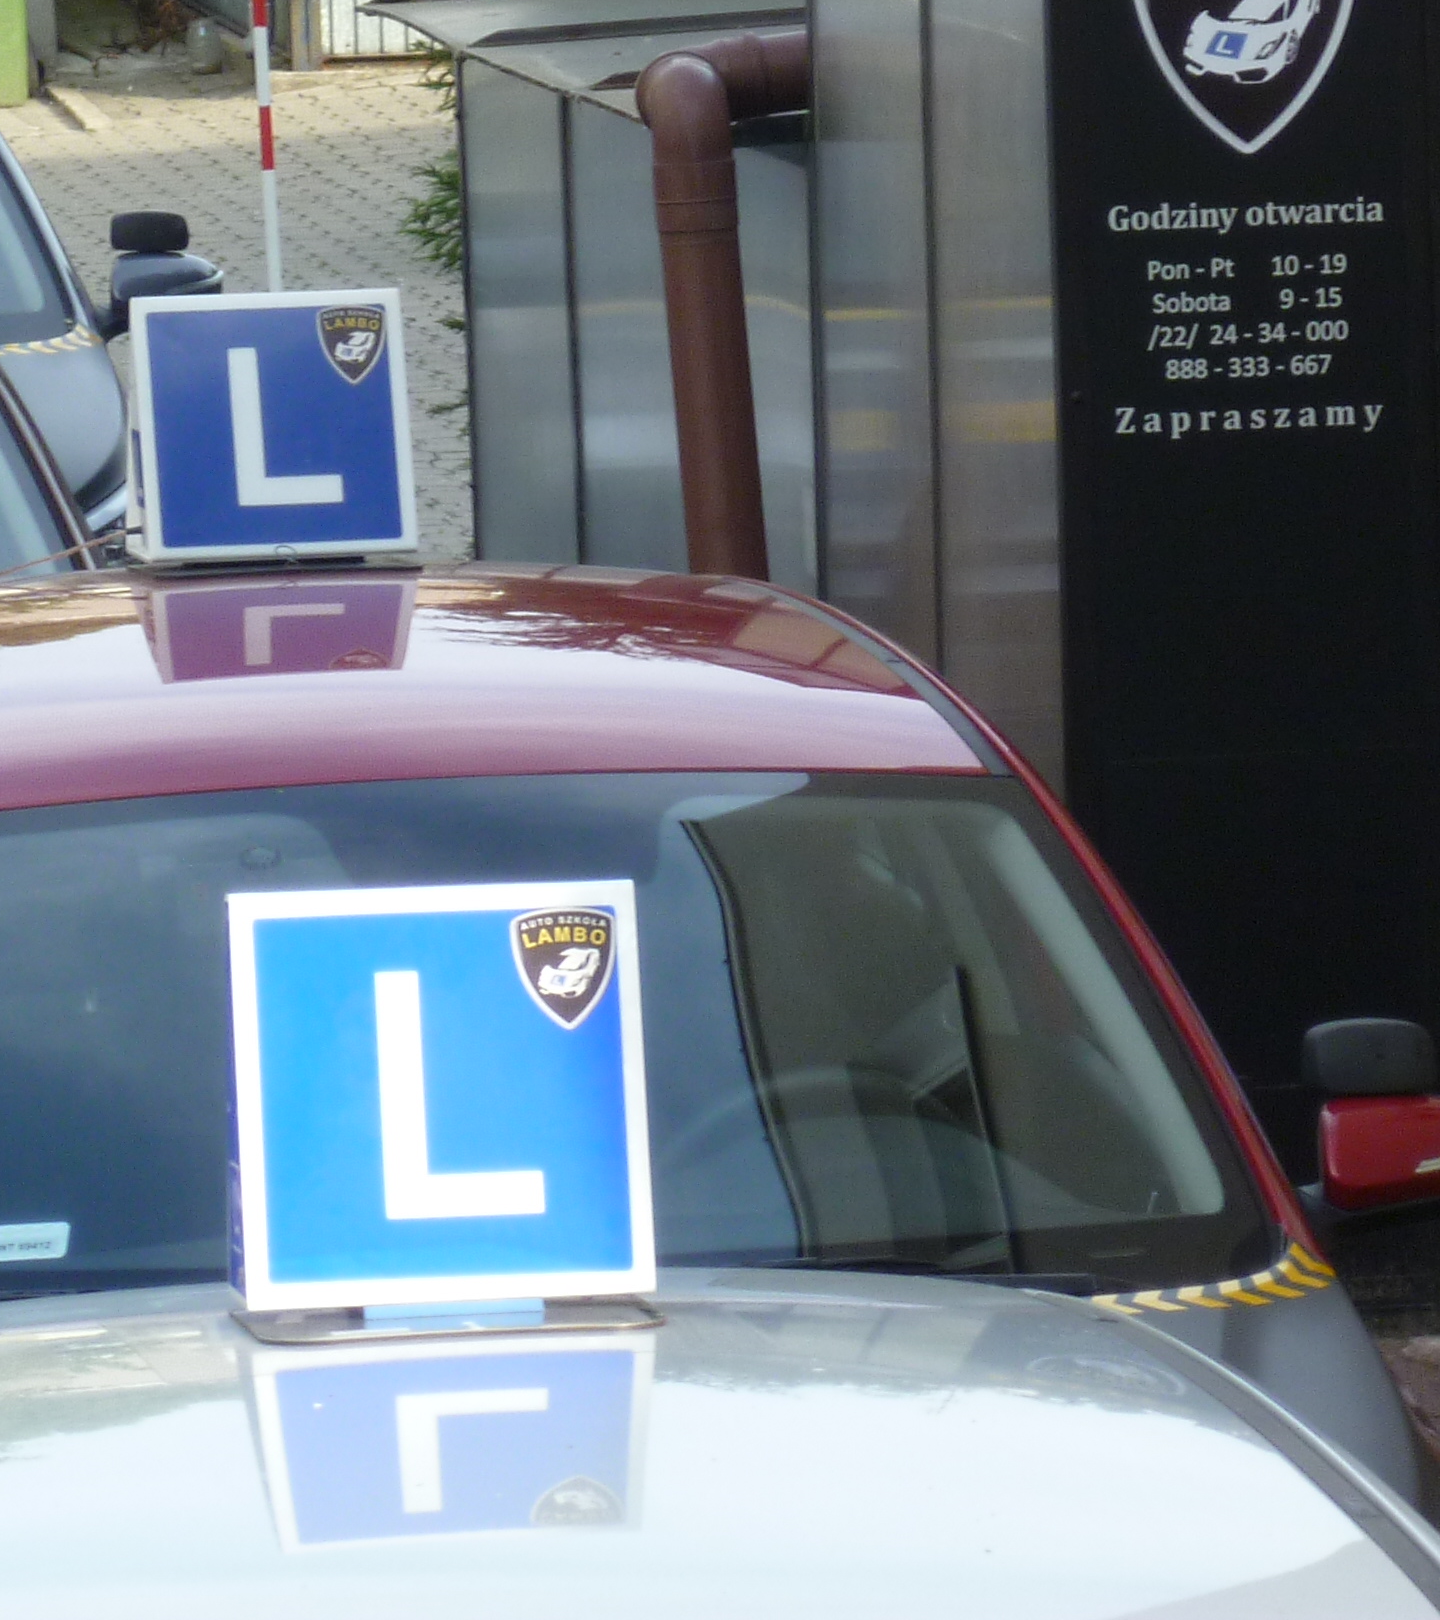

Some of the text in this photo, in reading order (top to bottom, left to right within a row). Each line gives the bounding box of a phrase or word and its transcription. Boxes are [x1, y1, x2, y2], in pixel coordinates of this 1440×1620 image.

[1108, 196, 1384, 234] Godziny otwarcia
[1148, 260, 1190, 281] Pon
[1211, 258, 1235, 279] Pt
[1271, 255, 1299, 276] 10
[1319, 253, 1348, 274] 19
[1152, 292, 1232, 314] Sobota
[1279, 288, 1295, 310] 9
[1315, 287, 1343, 308] 15
[1147, 323, 1199, 352] /22/
[1210, 324, 1238, 345] 24
[1258, 322, 1286, 343] 34
[1305, 320, 1349, 341] 000
[1165, 358, 1208, 380] 888
[1228, 356, 1270, 377] 333
[1290, 354, 1333, 375] 667
[227, 347, 344, 507] L
[1115, 402, 1383, 439] Zapraszamy
[520, 916, 554, 930] AUTO
[521, 926, 607, 948] LAMBO
[374, 971, 546, 1219] L
